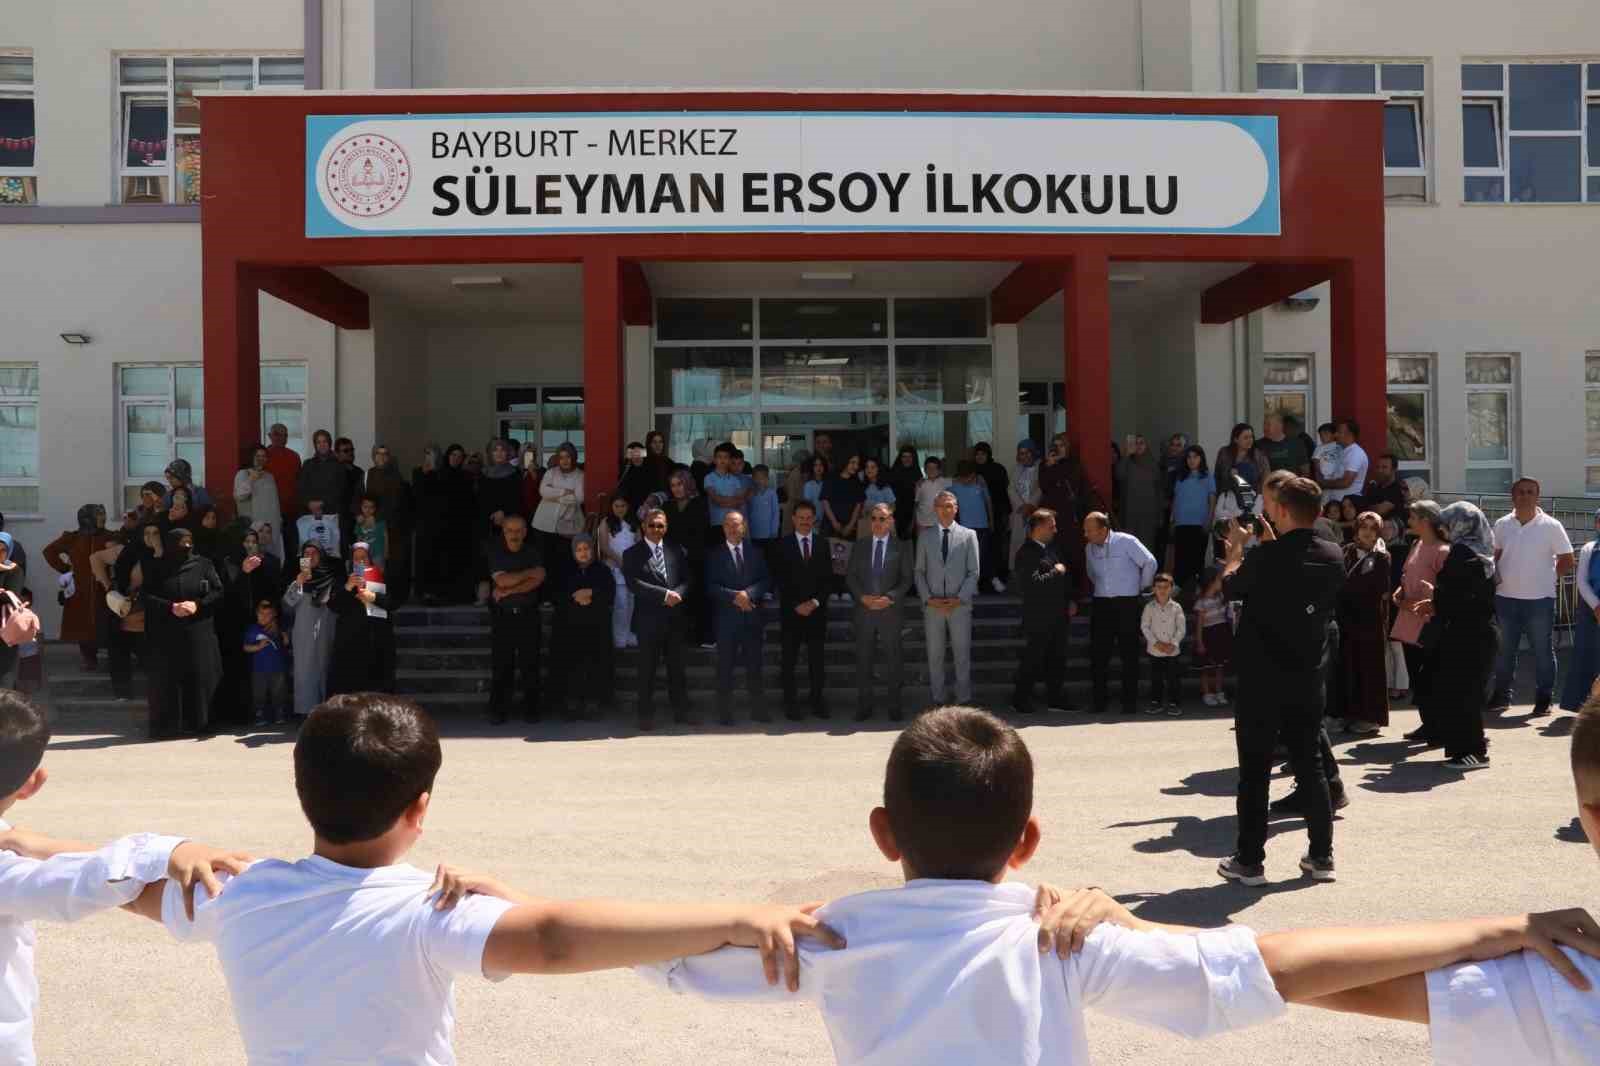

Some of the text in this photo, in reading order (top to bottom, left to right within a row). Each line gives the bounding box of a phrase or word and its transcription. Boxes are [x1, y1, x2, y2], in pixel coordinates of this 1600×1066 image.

[431, 130, 579, 159] BAYBURT
[608, 128, 738, 156] MERKEZ
[431, 165, 725, 217] SÜLEYMAN
[742, 171, 912, 214] ERSOY
[925, 162, 1178, 216] İLKOKULU
